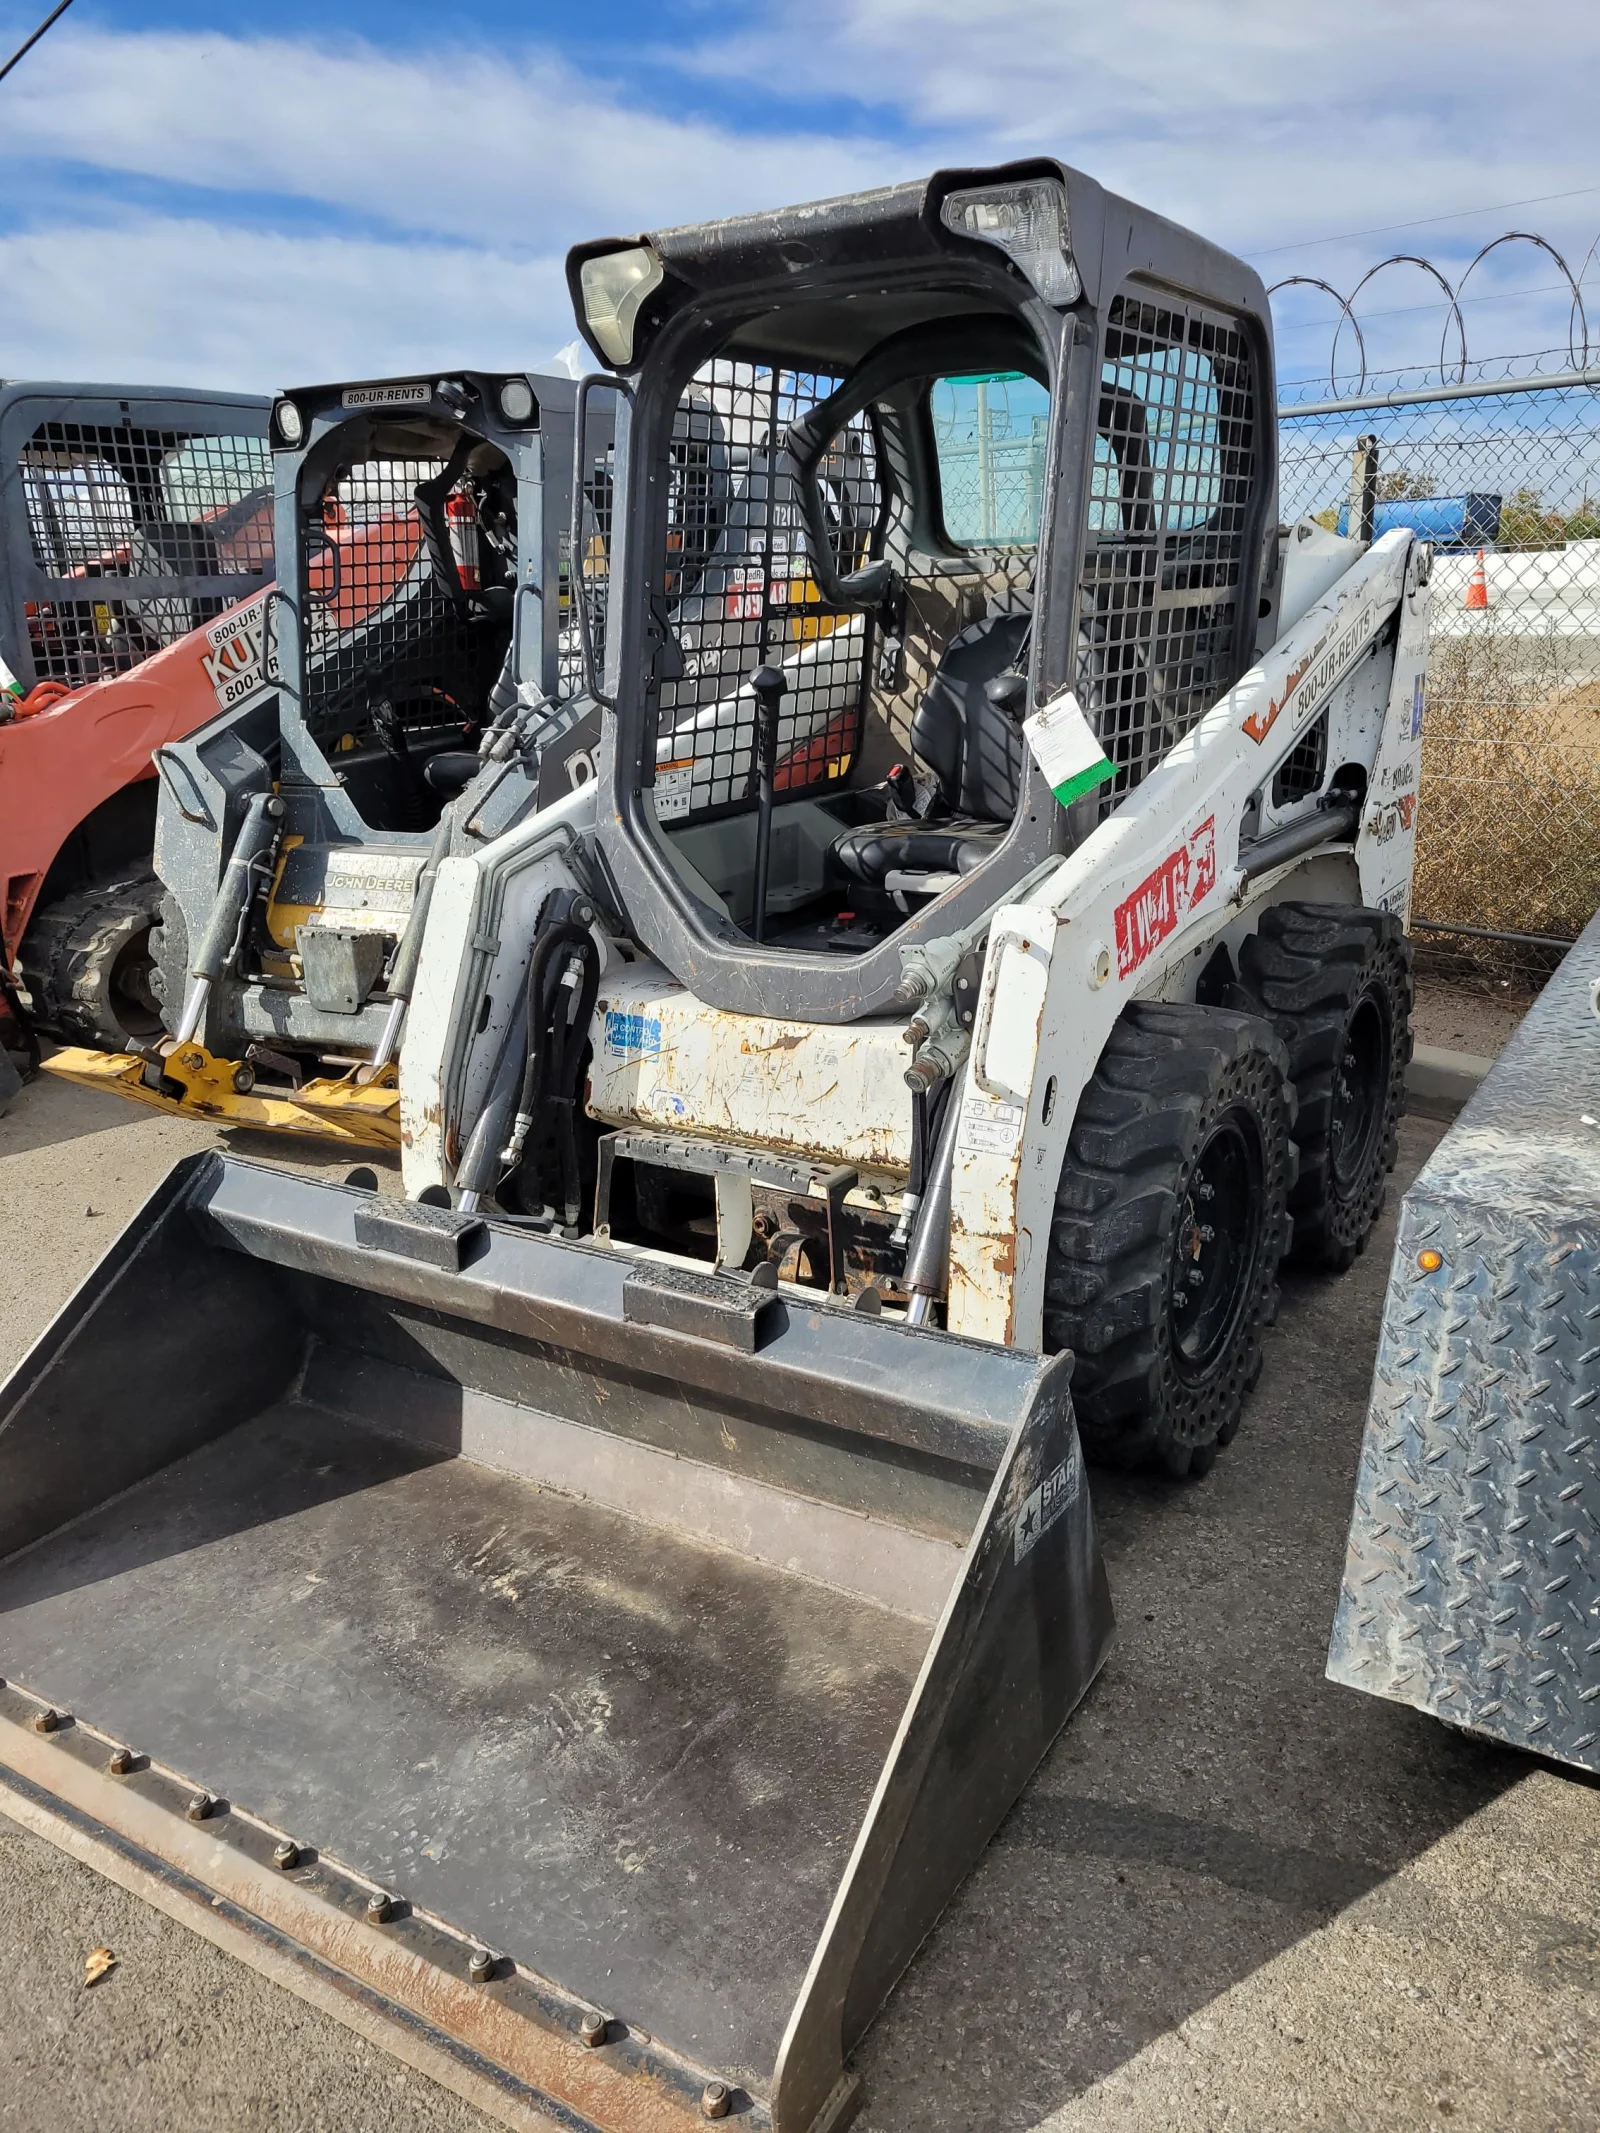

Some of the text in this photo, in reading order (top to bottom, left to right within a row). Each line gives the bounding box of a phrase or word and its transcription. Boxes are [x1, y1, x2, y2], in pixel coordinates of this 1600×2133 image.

[347, 388, 425, 404] 800-UR-RENTS
[1297, 608, 1371, 719] 800-UR-RENTS
[365, 876, 413, 892] DEERE
[1043, 1456, 1075, 1507] STAR
